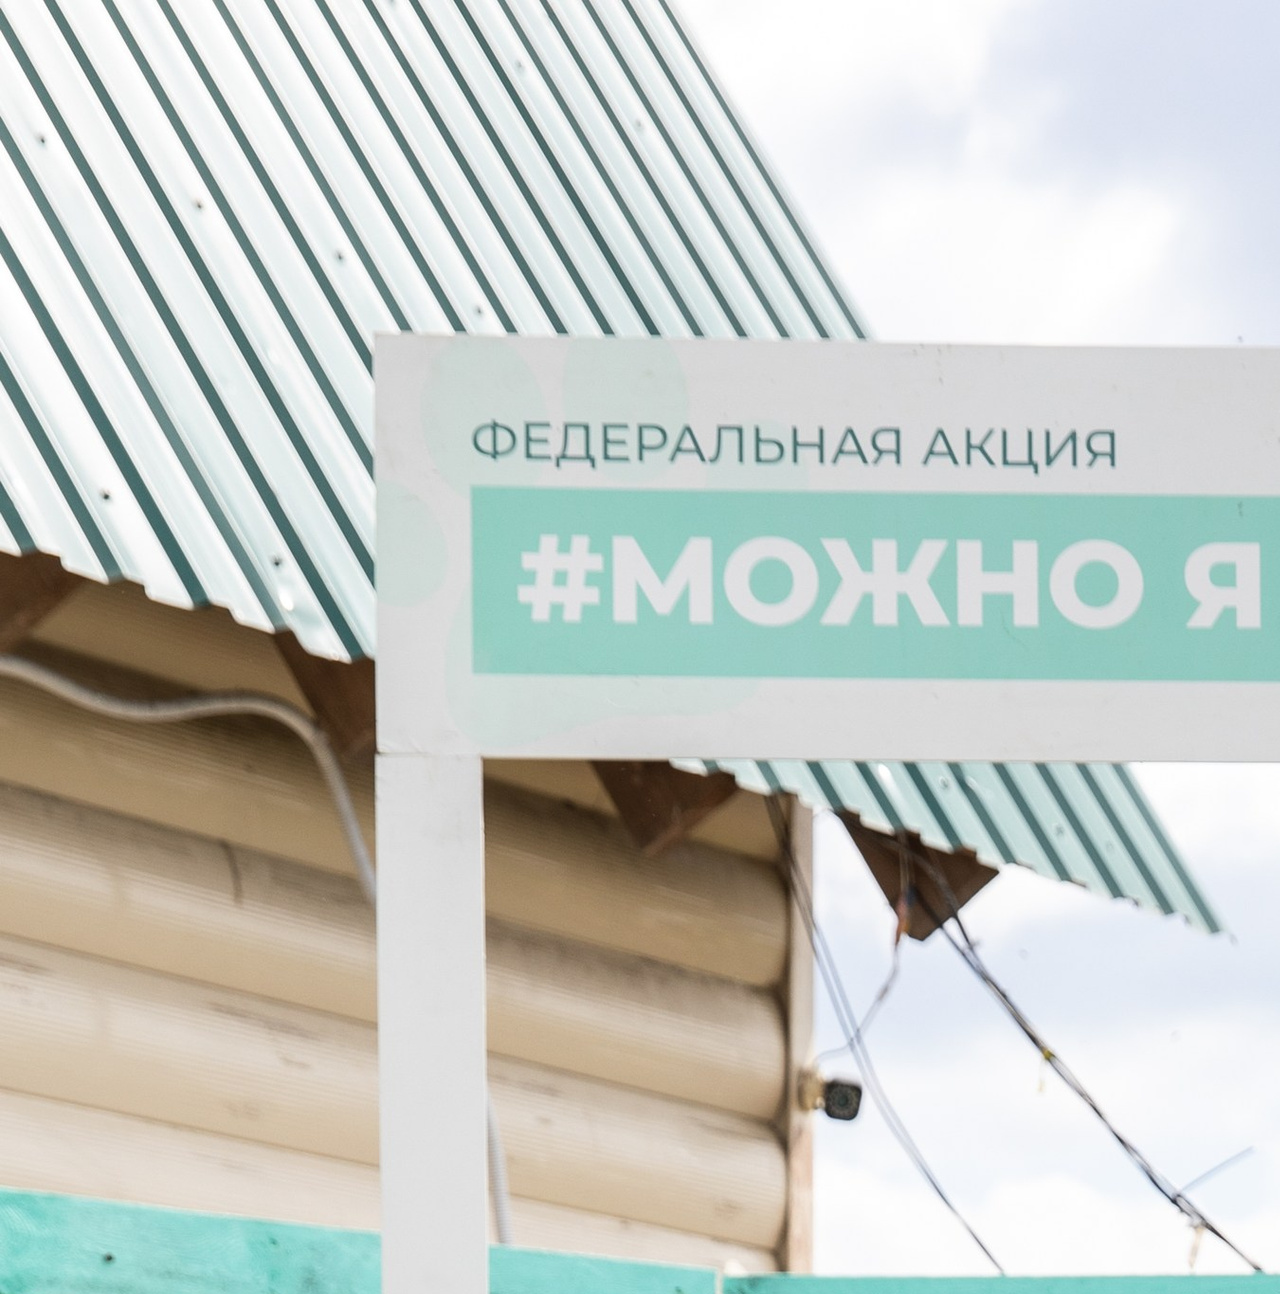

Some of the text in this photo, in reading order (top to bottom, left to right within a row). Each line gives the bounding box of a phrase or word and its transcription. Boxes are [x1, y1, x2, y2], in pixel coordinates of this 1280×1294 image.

[472, 420, 1118, 475] ФЕДЕРАЛЬНАЯ АКЦИЯ
[517, 534, 1144, 630] #МОЖНО
[1184, 542, 1261, 630] Я
